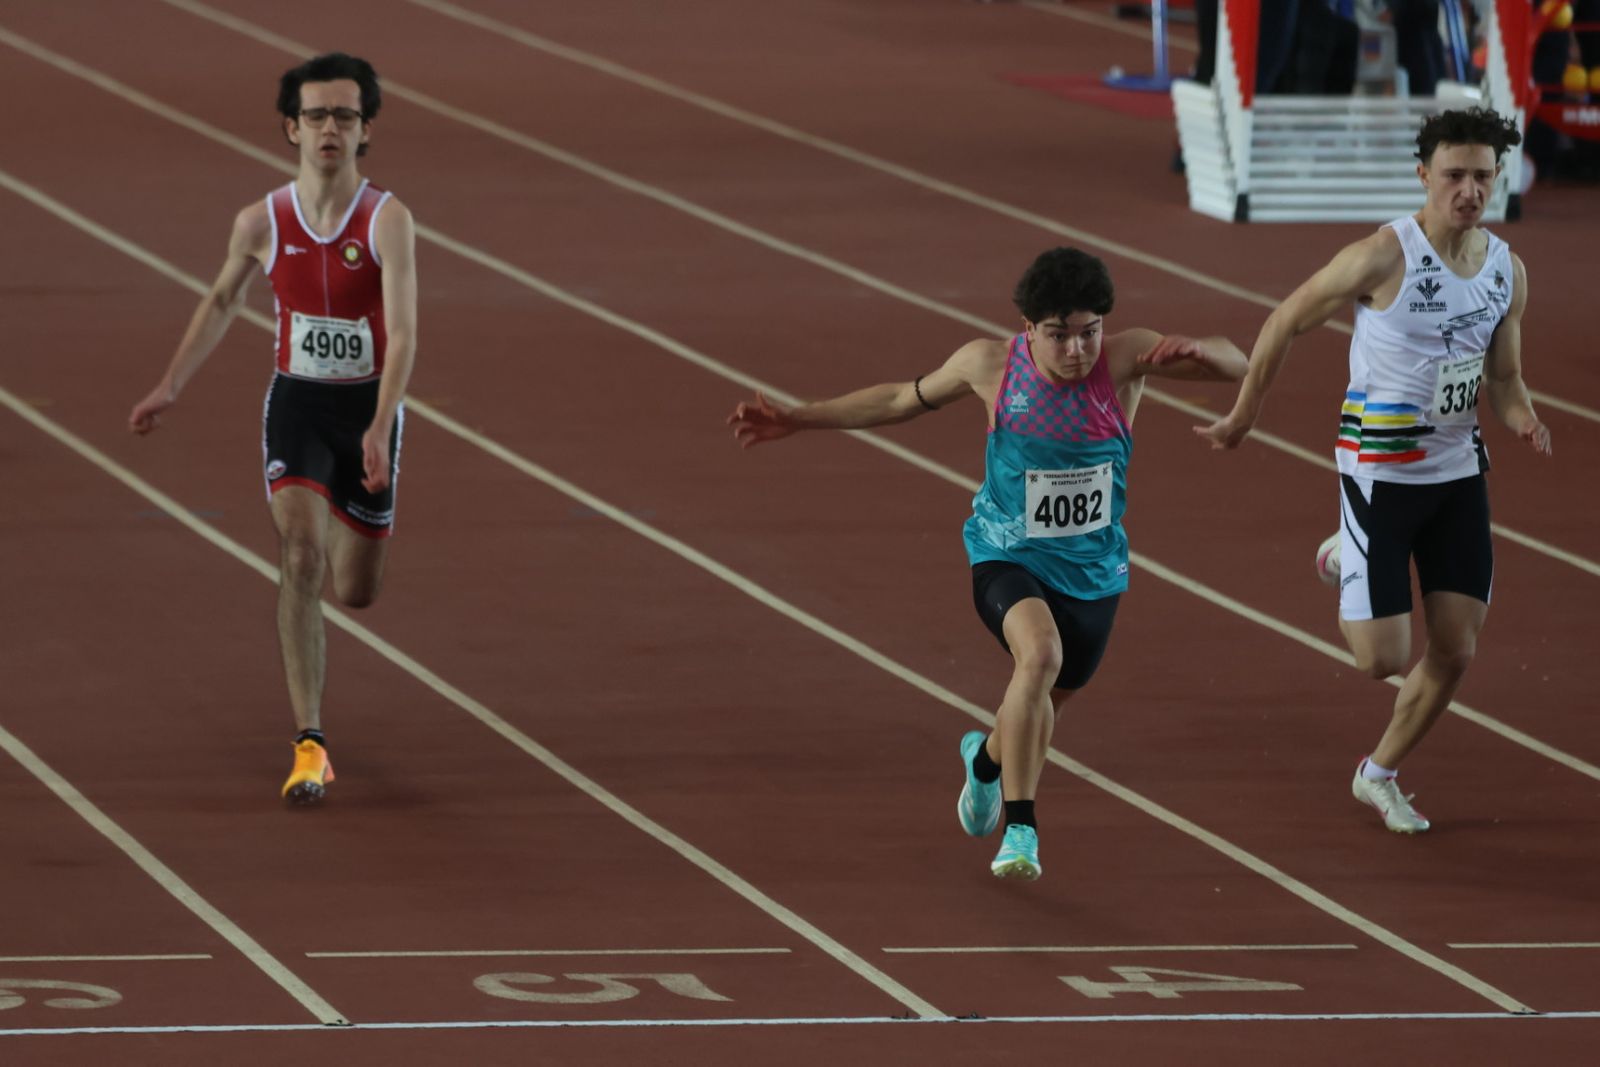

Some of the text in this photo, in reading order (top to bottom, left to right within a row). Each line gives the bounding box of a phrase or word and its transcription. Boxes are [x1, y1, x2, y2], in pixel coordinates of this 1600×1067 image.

[301, 330, 362, 360] 4909
[1440, 375, 1482, 415] 3382
[1034, 489, 1103, 528] 4082
[473, 971, 733, 1004] 5
[1058, 965, 1304, 999] 4
